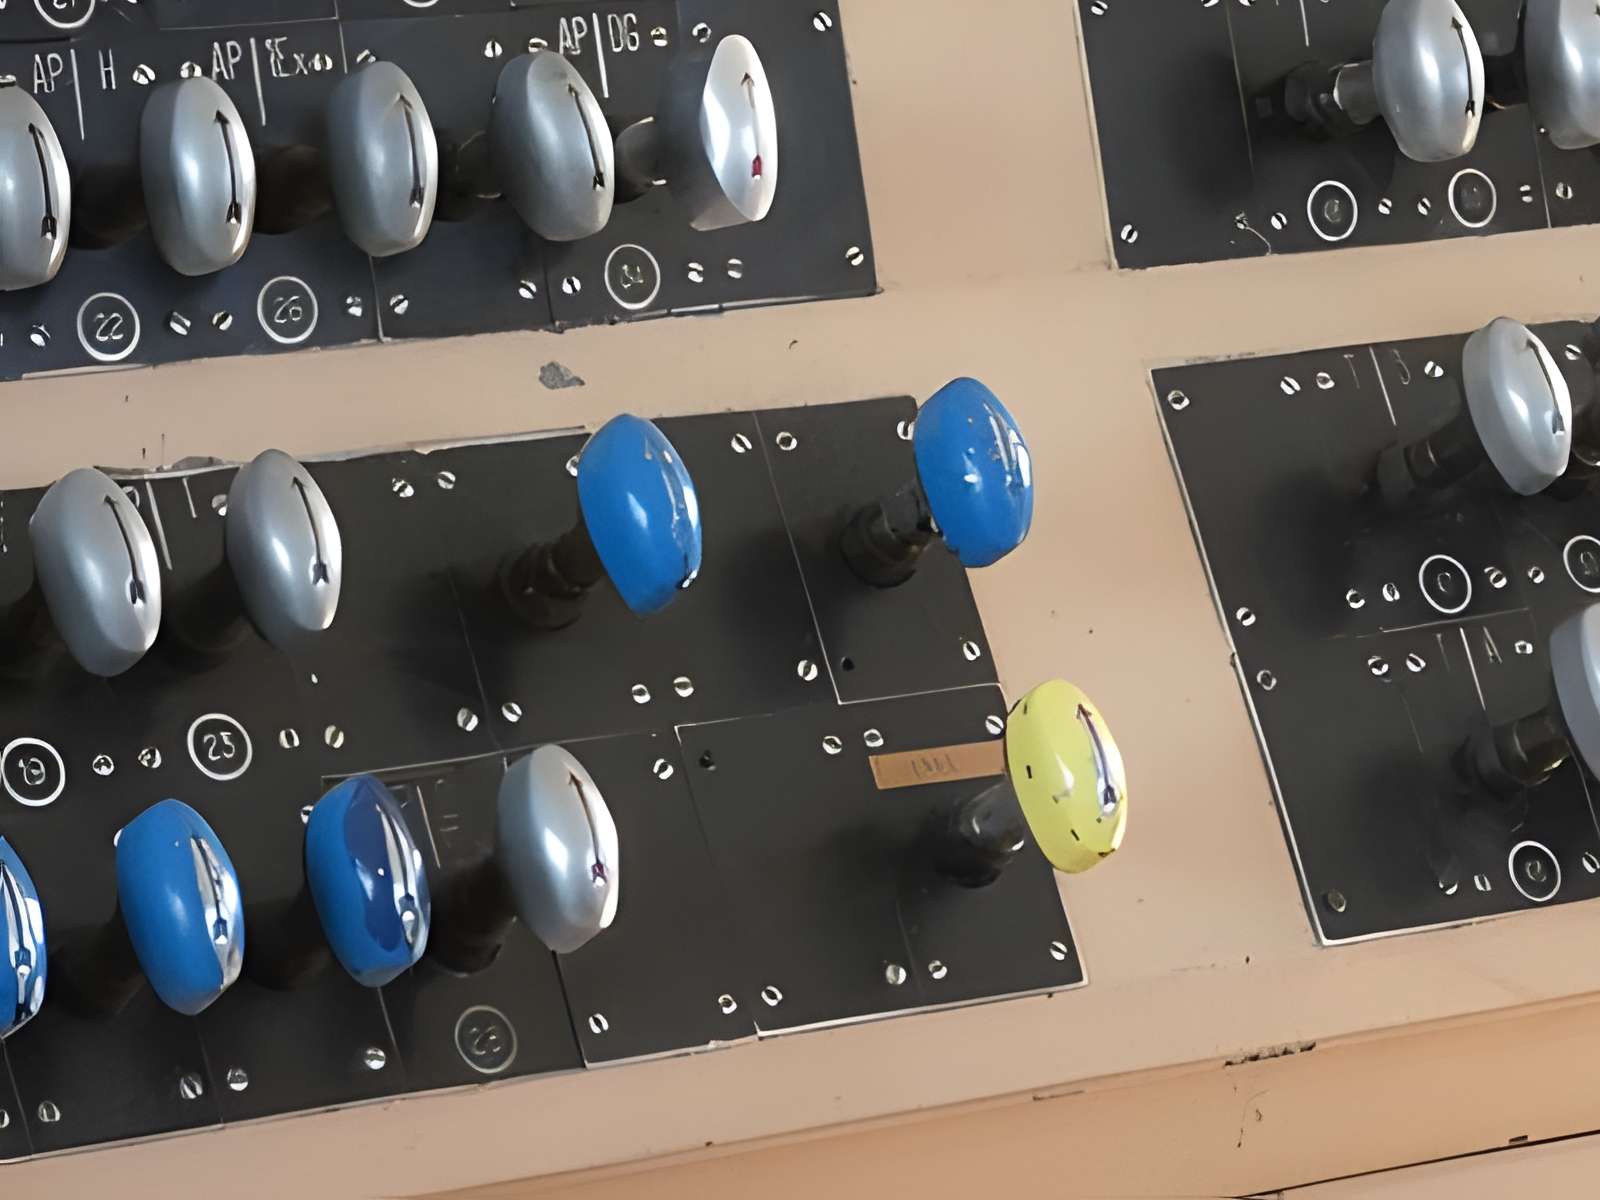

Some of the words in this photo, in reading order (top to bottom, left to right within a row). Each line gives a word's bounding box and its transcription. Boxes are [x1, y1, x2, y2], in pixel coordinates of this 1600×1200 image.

[558, 16, 588, 56] AP
[33, 52, 64, 95] AP
[212, 40, 242, 81] AP
[201, 730, 236, 762] 25
